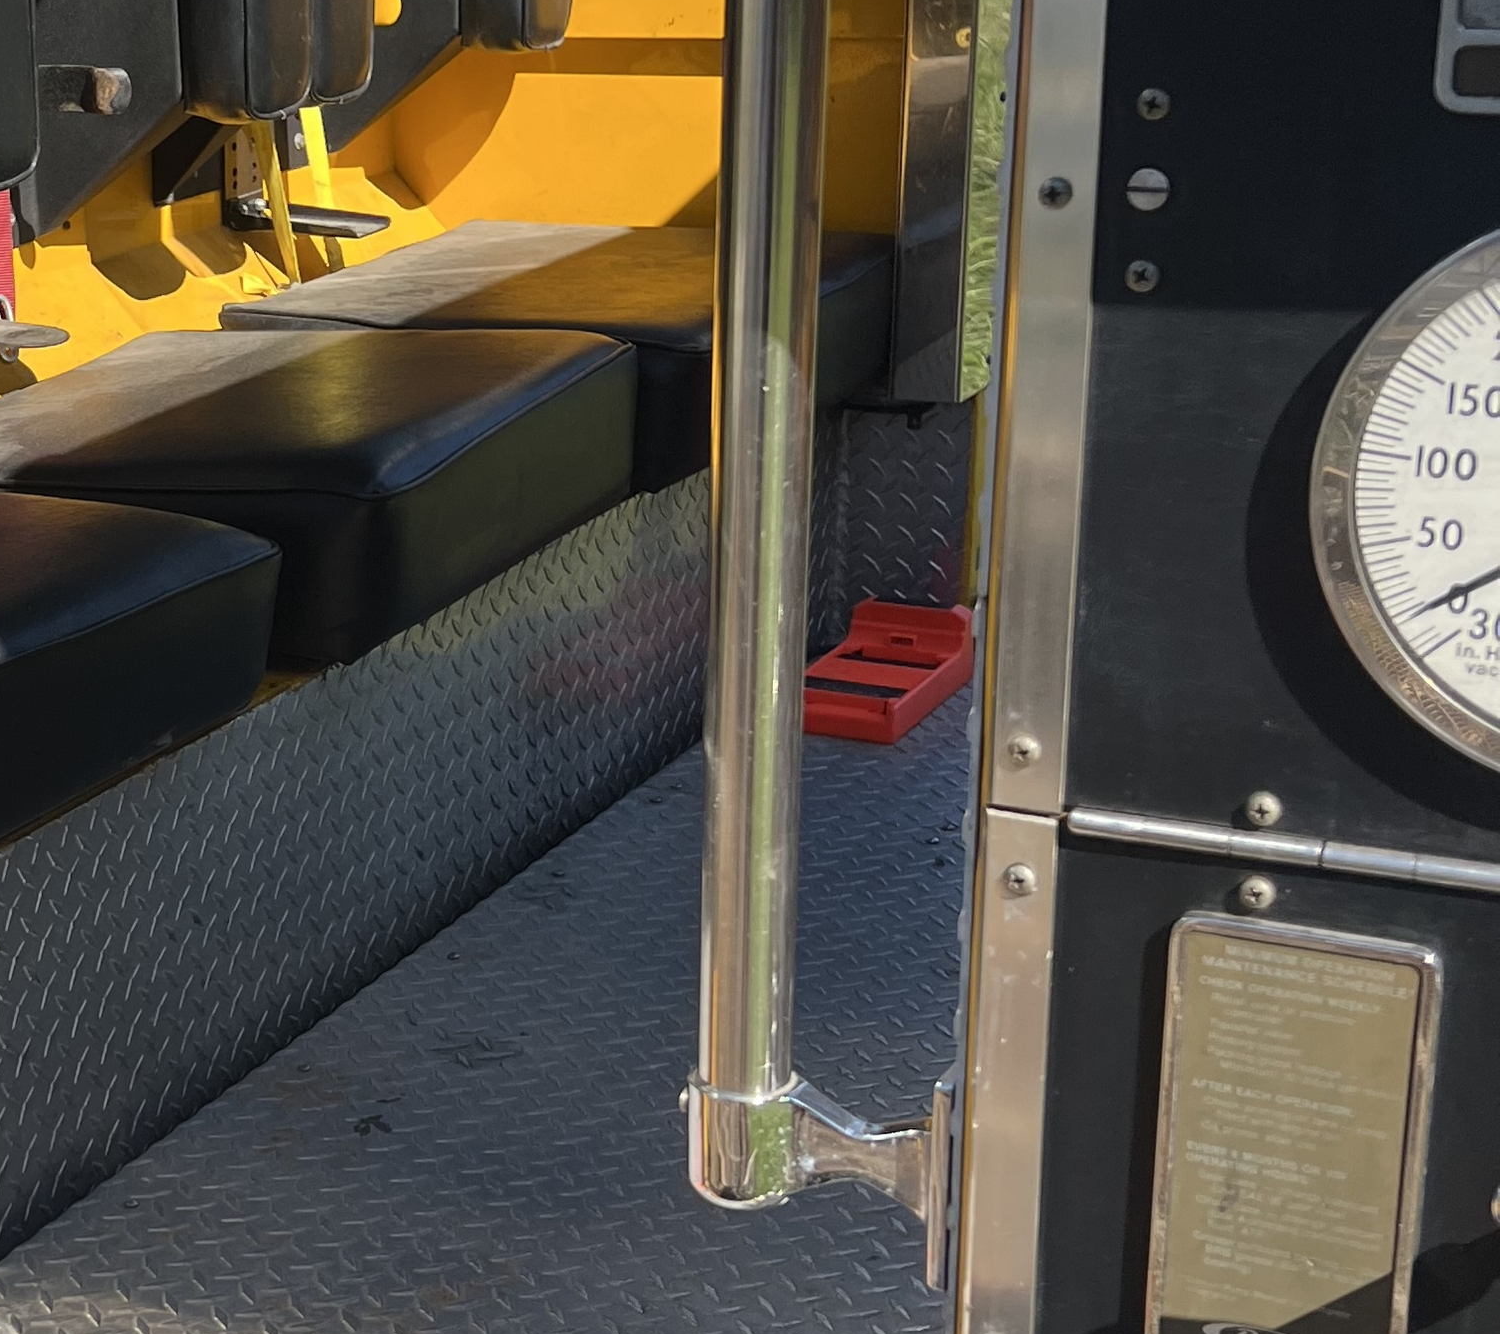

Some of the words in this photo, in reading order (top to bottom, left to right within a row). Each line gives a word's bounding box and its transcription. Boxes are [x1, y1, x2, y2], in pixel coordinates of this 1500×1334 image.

[1447, 381, 1500, 418] 150
[1416, 445, 1477, 481] 100
[1417, 516, 1463, 551] 50
[1448, 583, 1468, 615] 0
[1469, 607, 1500, 642] 3
